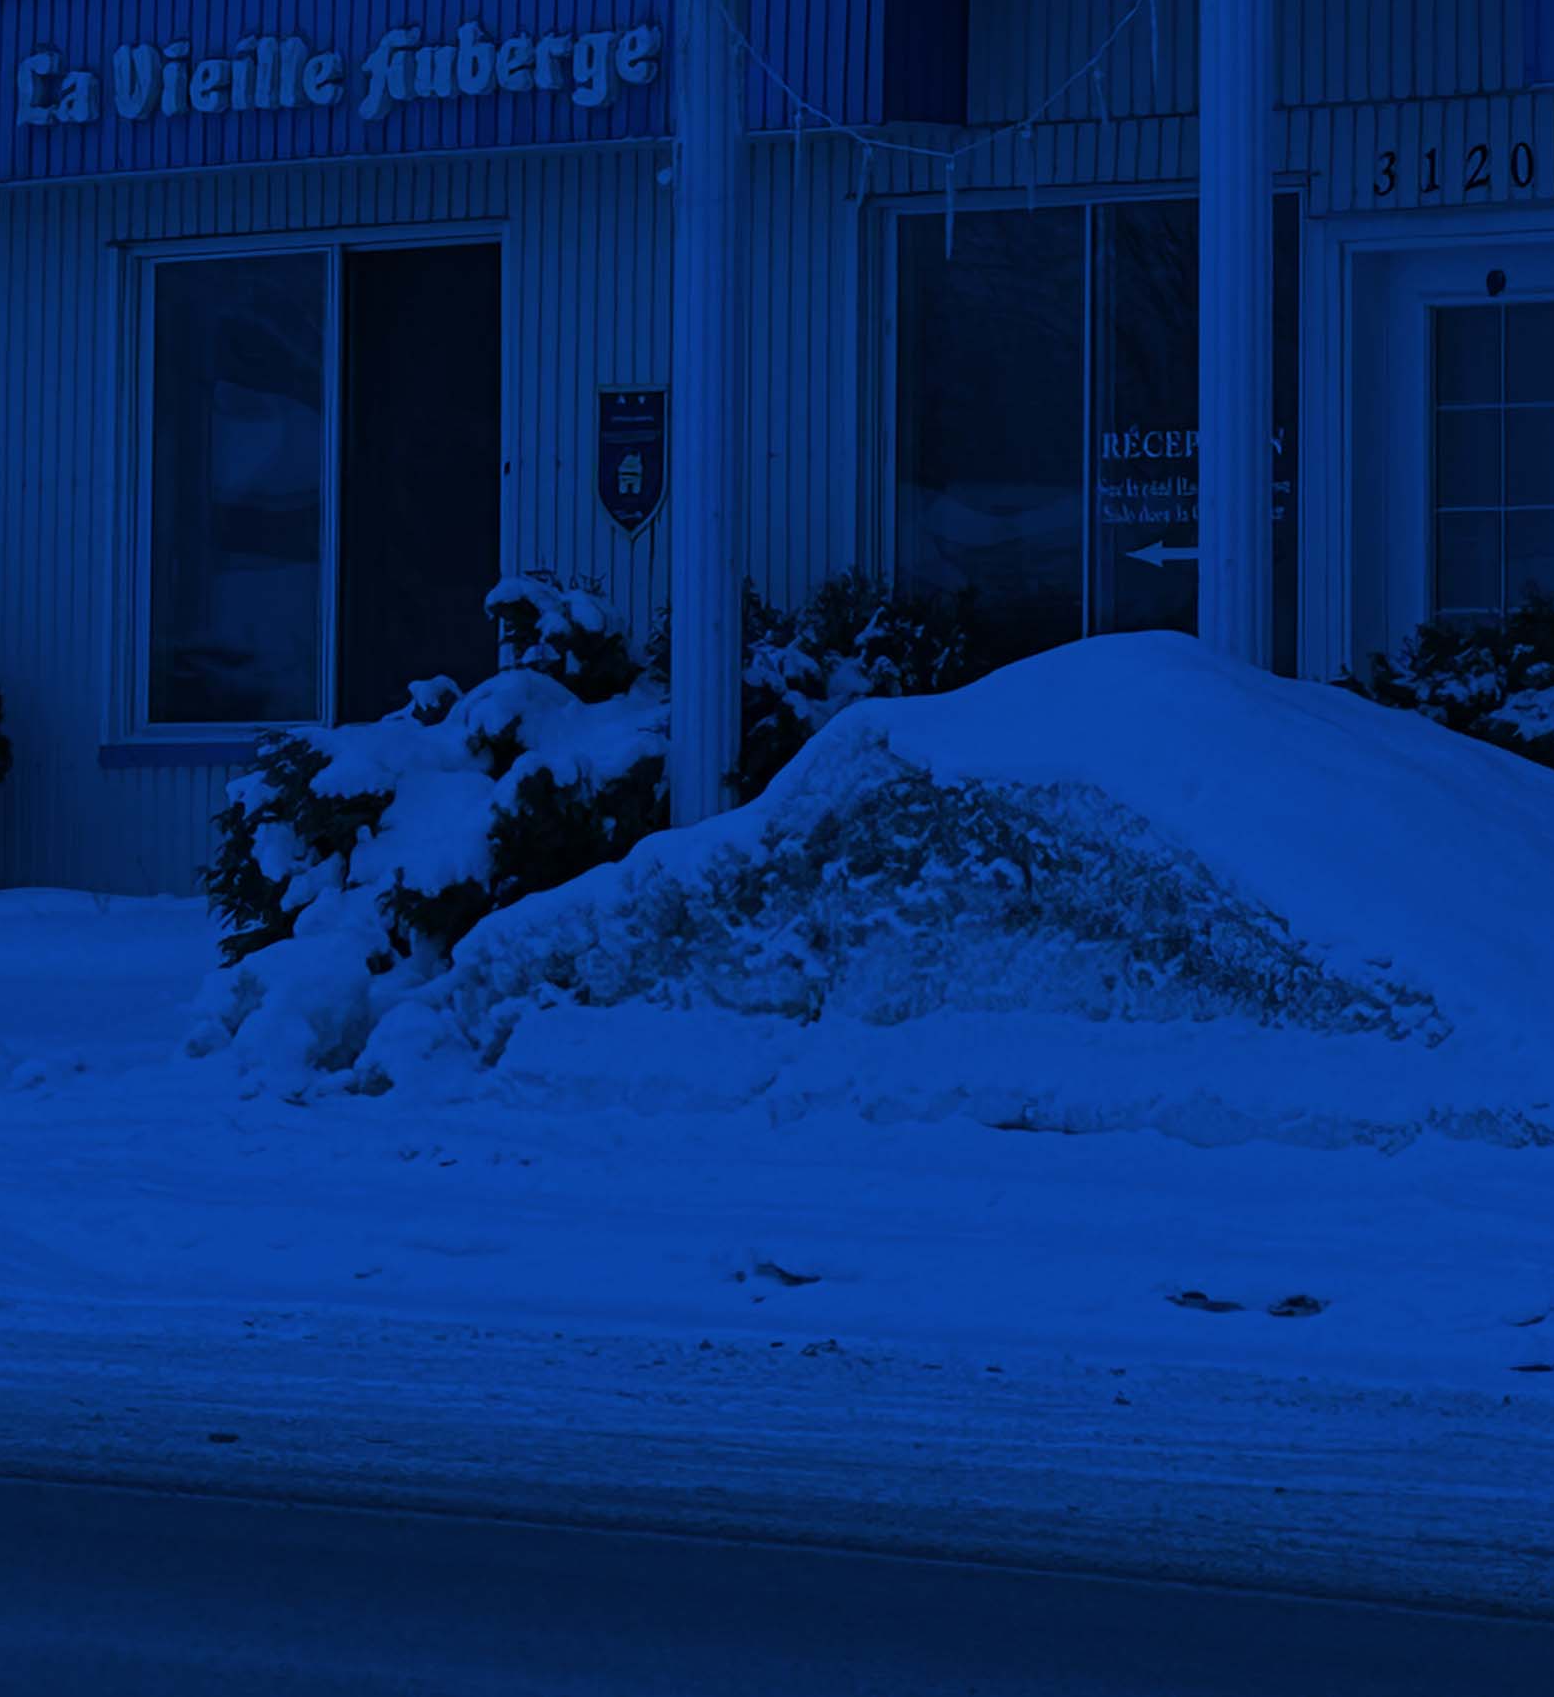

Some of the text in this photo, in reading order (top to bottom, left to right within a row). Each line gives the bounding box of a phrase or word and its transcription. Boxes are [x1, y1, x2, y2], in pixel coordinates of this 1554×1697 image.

[15, 16, 662, 128] La Vieille Auberge
[1372, 141, 1535, 197] 3120
